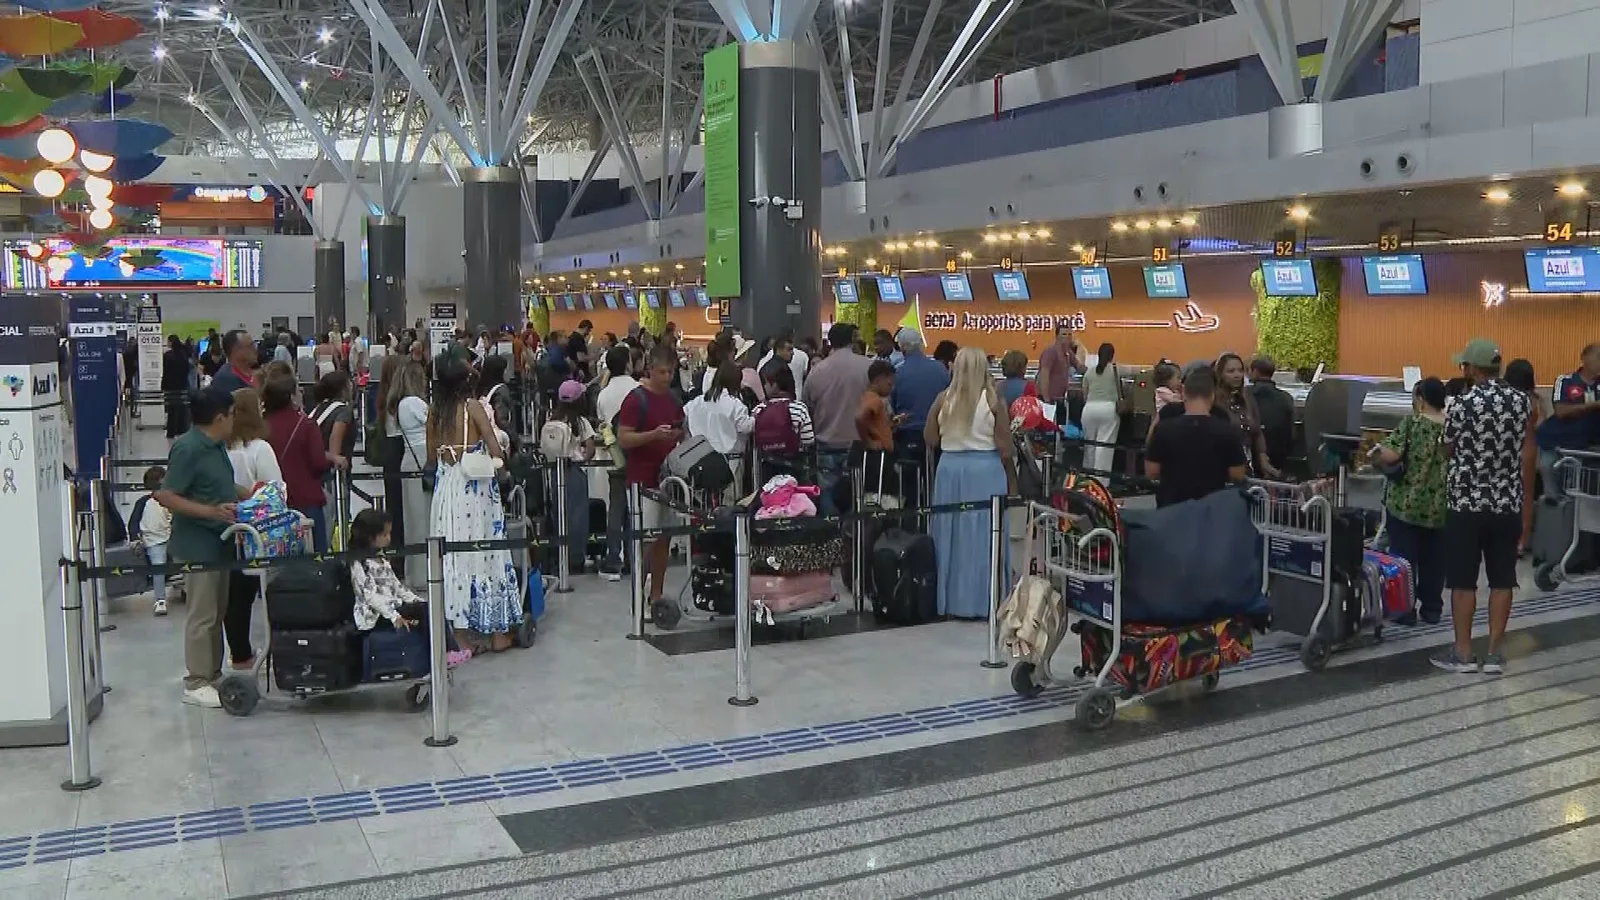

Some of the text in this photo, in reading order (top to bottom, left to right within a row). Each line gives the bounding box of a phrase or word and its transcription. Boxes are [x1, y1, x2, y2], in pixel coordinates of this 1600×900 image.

[1547, 223, 1572, 241] 54
[1276, 241, 1293, 256] 52
[1380, 234, 1398, 251] 53
[1081, 252, 1095, 264] 50
[1153, 247, 1167, 261] 51
[882, 264, 891, 276] 47
[1000, 257, 1011, 269] 49
[1547, 261, 1570, 275] Azul
[1277, 269, 1292, 281] Azul
[1380, 266, 1398, 279] Azul
[924, 311, 1087, 334] aena Aeroportos para você
[74, 326, 95, 334] Azul
[33, 374, 51, 396] Azul
